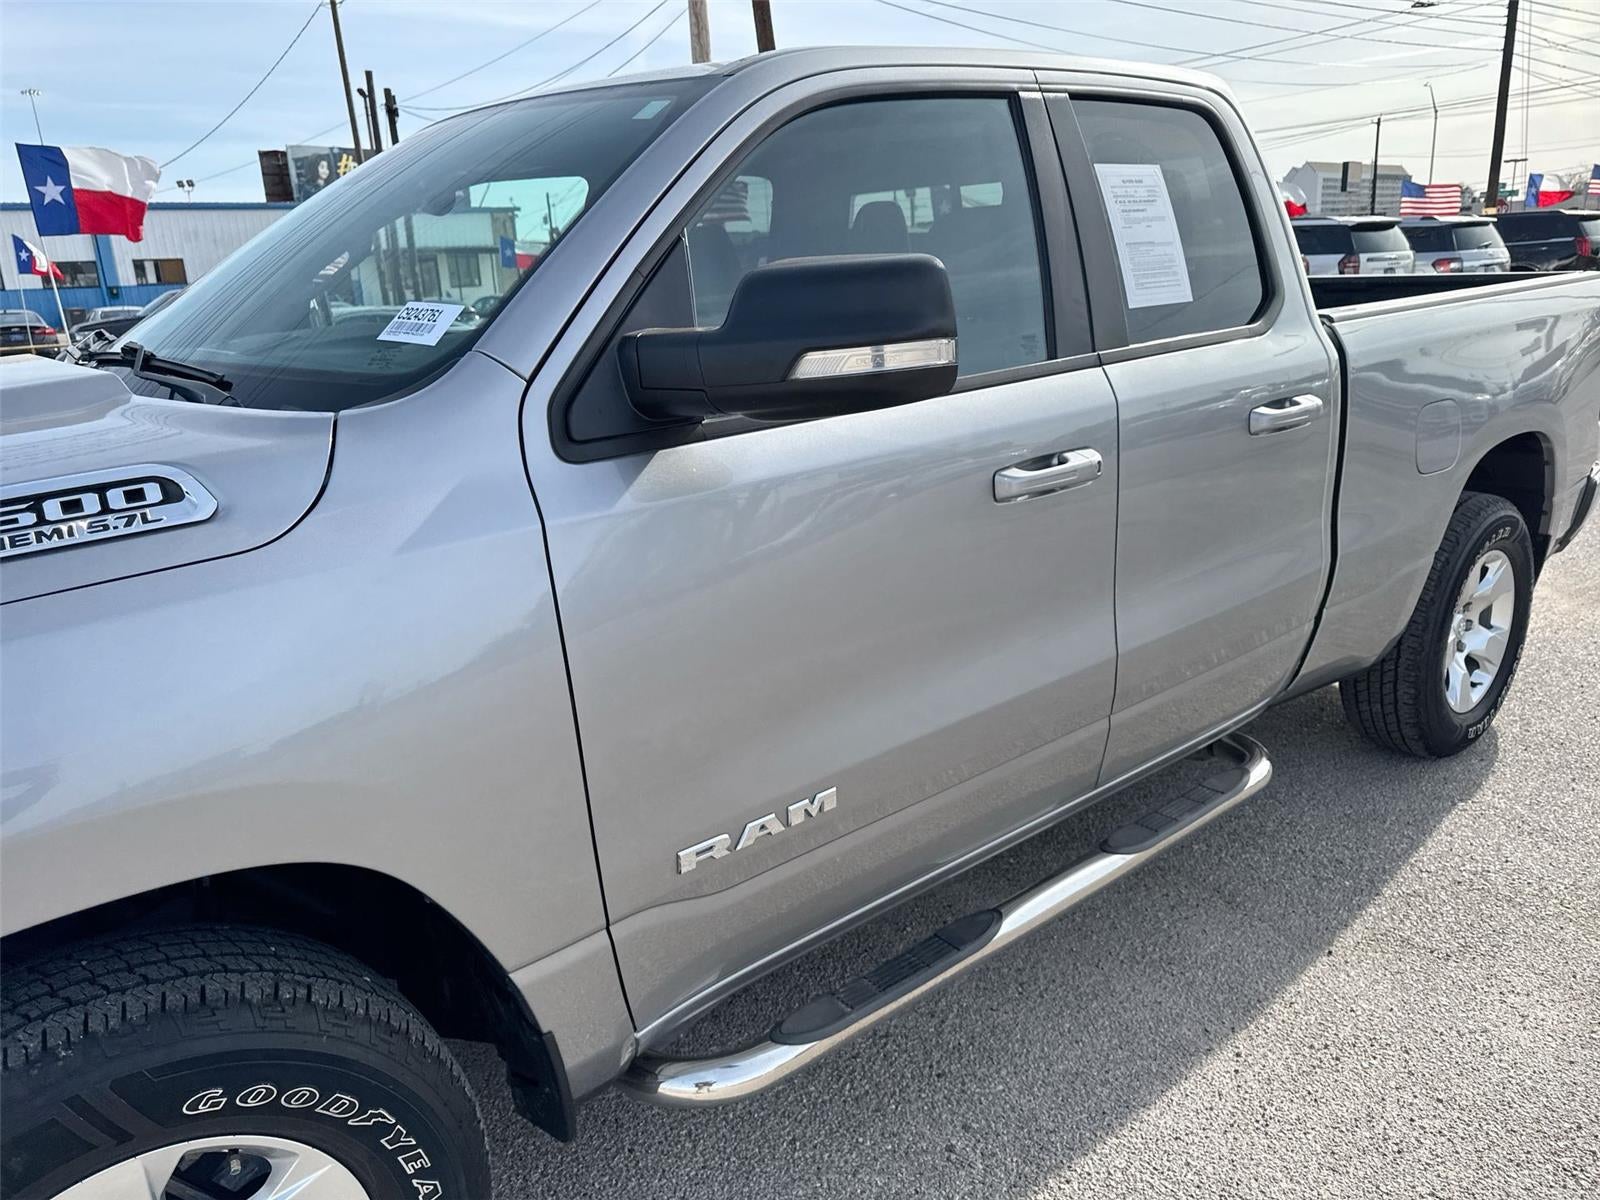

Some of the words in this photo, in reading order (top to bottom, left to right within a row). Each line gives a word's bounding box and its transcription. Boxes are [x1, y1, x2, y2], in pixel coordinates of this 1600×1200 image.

[397, 306, 443, 323] C9243761
[0, 522, 77, 551] EMI
[86, 510, 167, 535] 5.7L
[676, 786, 837, 875] RAM
